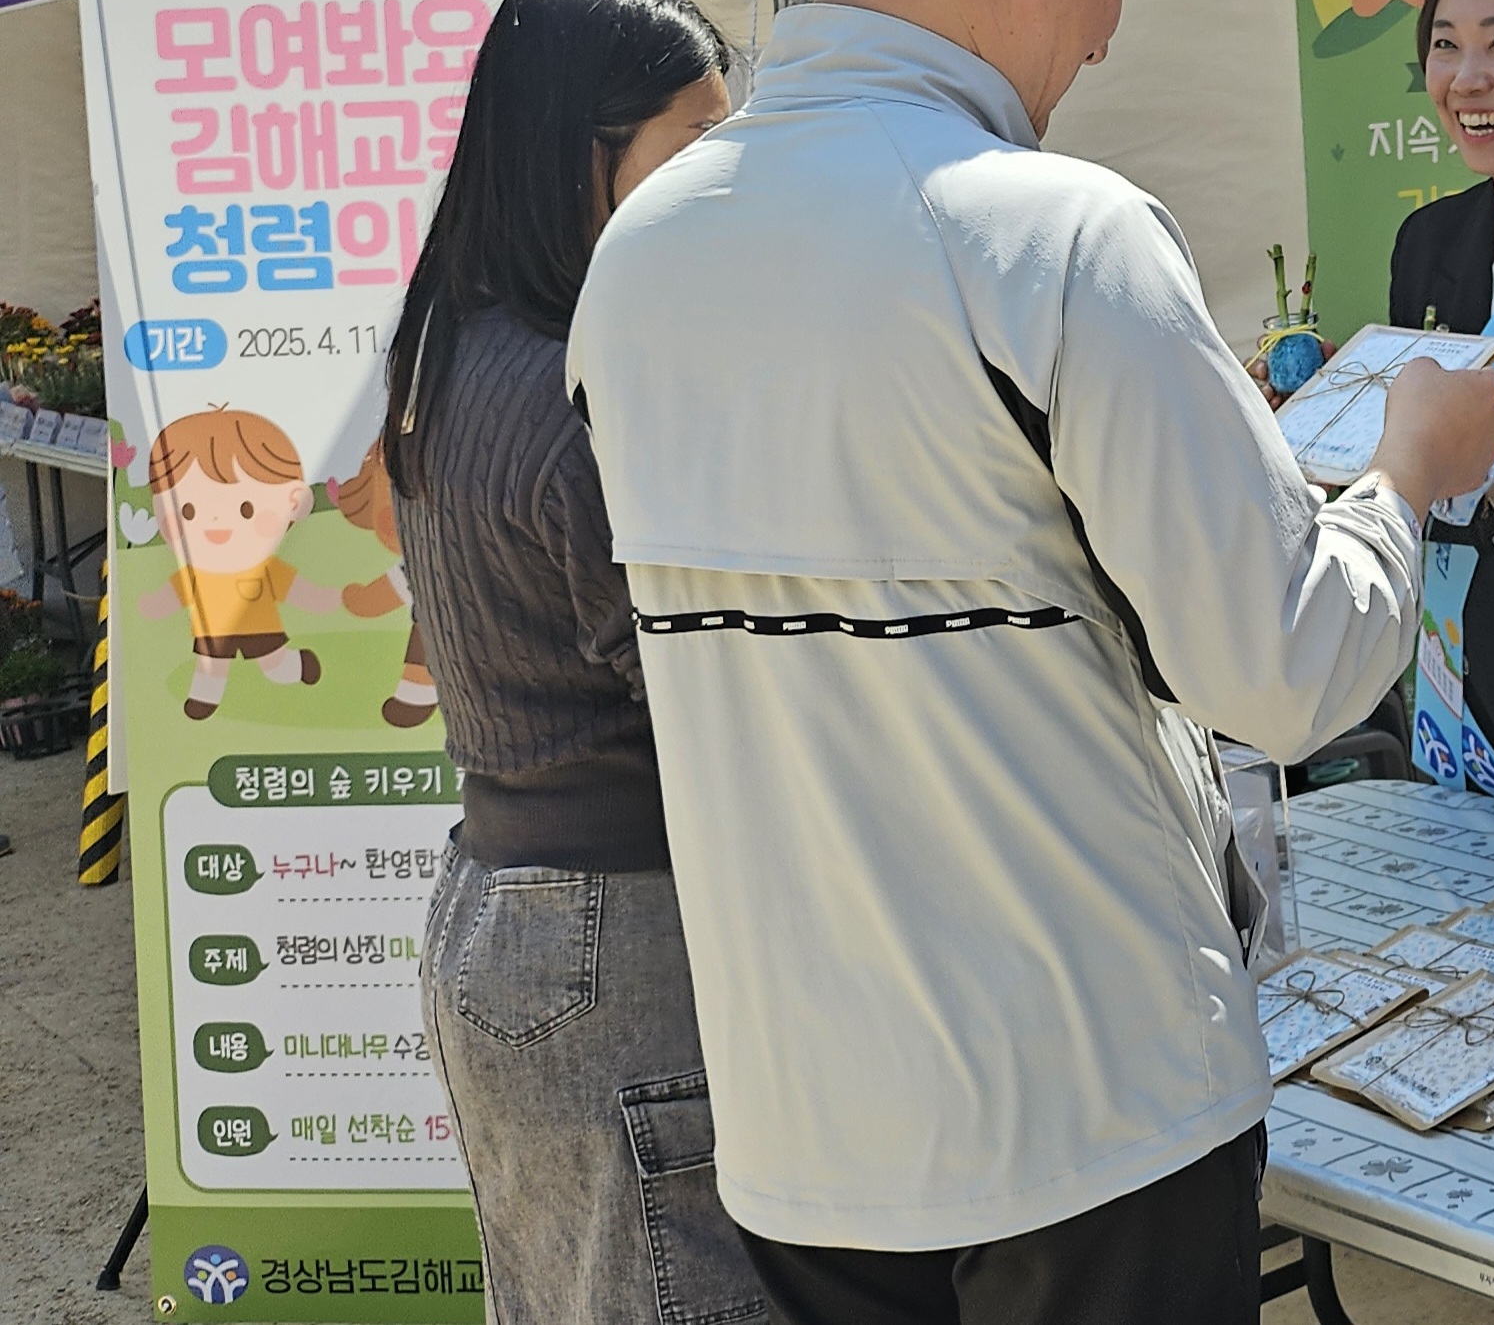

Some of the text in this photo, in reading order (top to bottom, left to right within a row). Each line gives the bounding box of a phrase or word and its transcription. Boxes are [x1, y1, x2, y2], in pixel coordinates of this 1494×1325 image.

[163, 197, 421, 296] 청렴의
[147, 326, 208, 363] 기간
[235, 765, 315, 802] 청렴의
[329, 767, 352, 801] 숲
[365, 764, 443, 798] 키우기
[197, 853, 247, 881] 대상
[204, 947, 249, 974] 주제
[275, 935, 339, 967] 청렴의
[342, 935, 386, 965] 상징
[209, 1033, 249, 1063] 내용
[283, 1033, 389, 1060] 미니대나무
[212, 1119, 252, 1148] 인원
[291, 1114, 337, 1145] 매일
[347, 1113, 416, 1144] 선착순
[260, 1258, 486, 1296] 경상남도김해교
